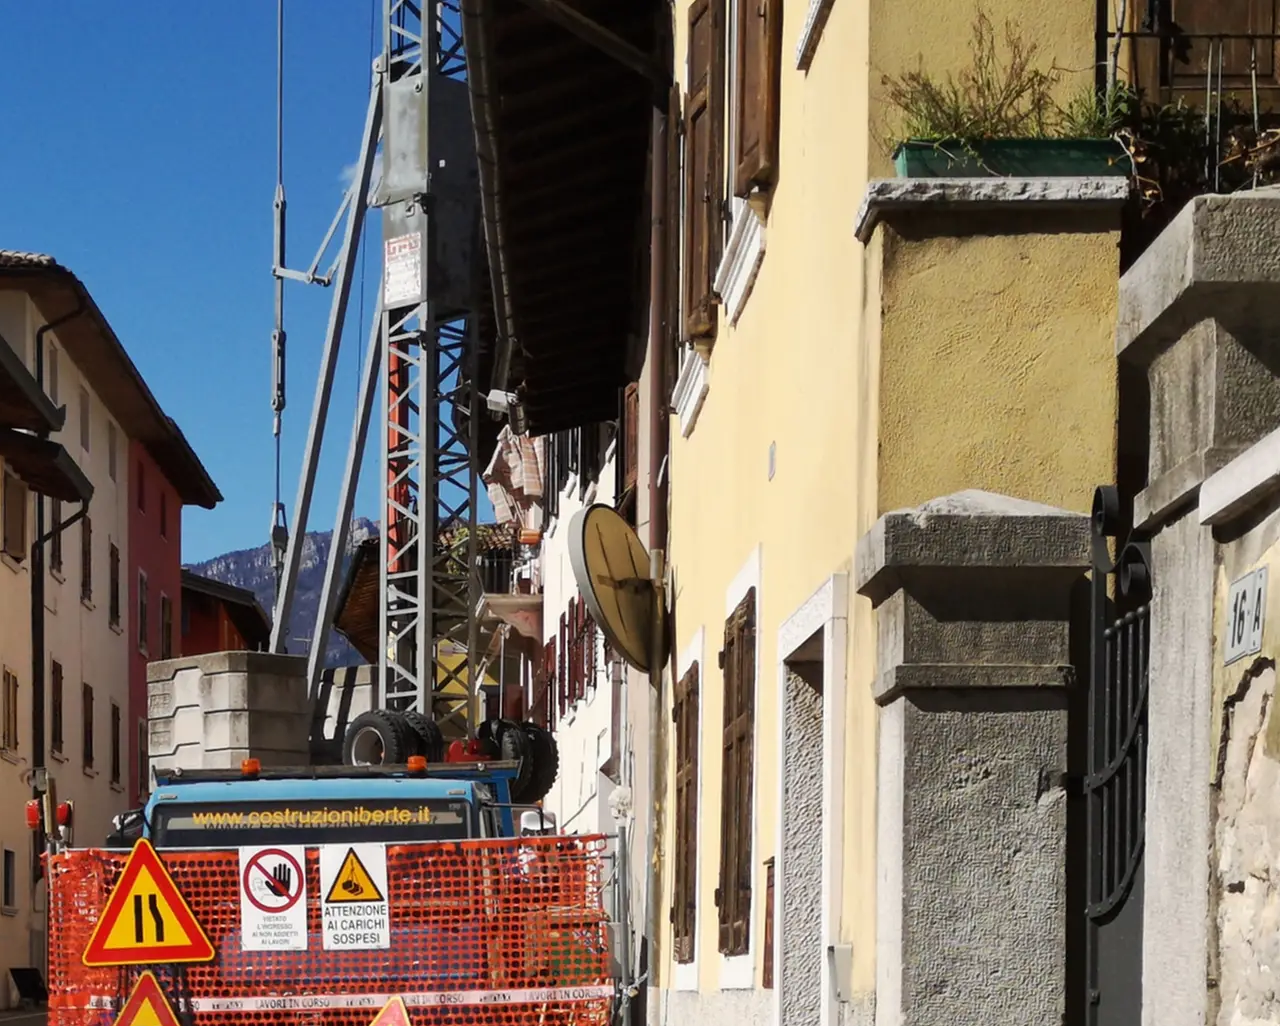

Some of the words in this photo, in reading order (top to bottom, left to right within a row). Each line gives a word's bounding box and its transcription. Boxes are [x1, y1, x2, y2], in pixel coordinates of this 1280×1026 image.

[1231, 588, 1247, 648] 16
[1252, 587, 1262, 633] A
[192, 806, 430, 825] www.costruzioniberte.it
[324, 904, 387, 917] ATTENZIONE
[327, 920, 338, 930] AI
[340, 919, 385, 930] CARICHI
[332, 932, 380, 945] SOSPESI
[523, 990, 557, 1002] LAVORI
[560, 989, 570, 1000] IN
[255, 998, 286, 1010] LAVORI
[289, 998, 299, 1008] IN
[302, 997, 330, 1008] CORSO
